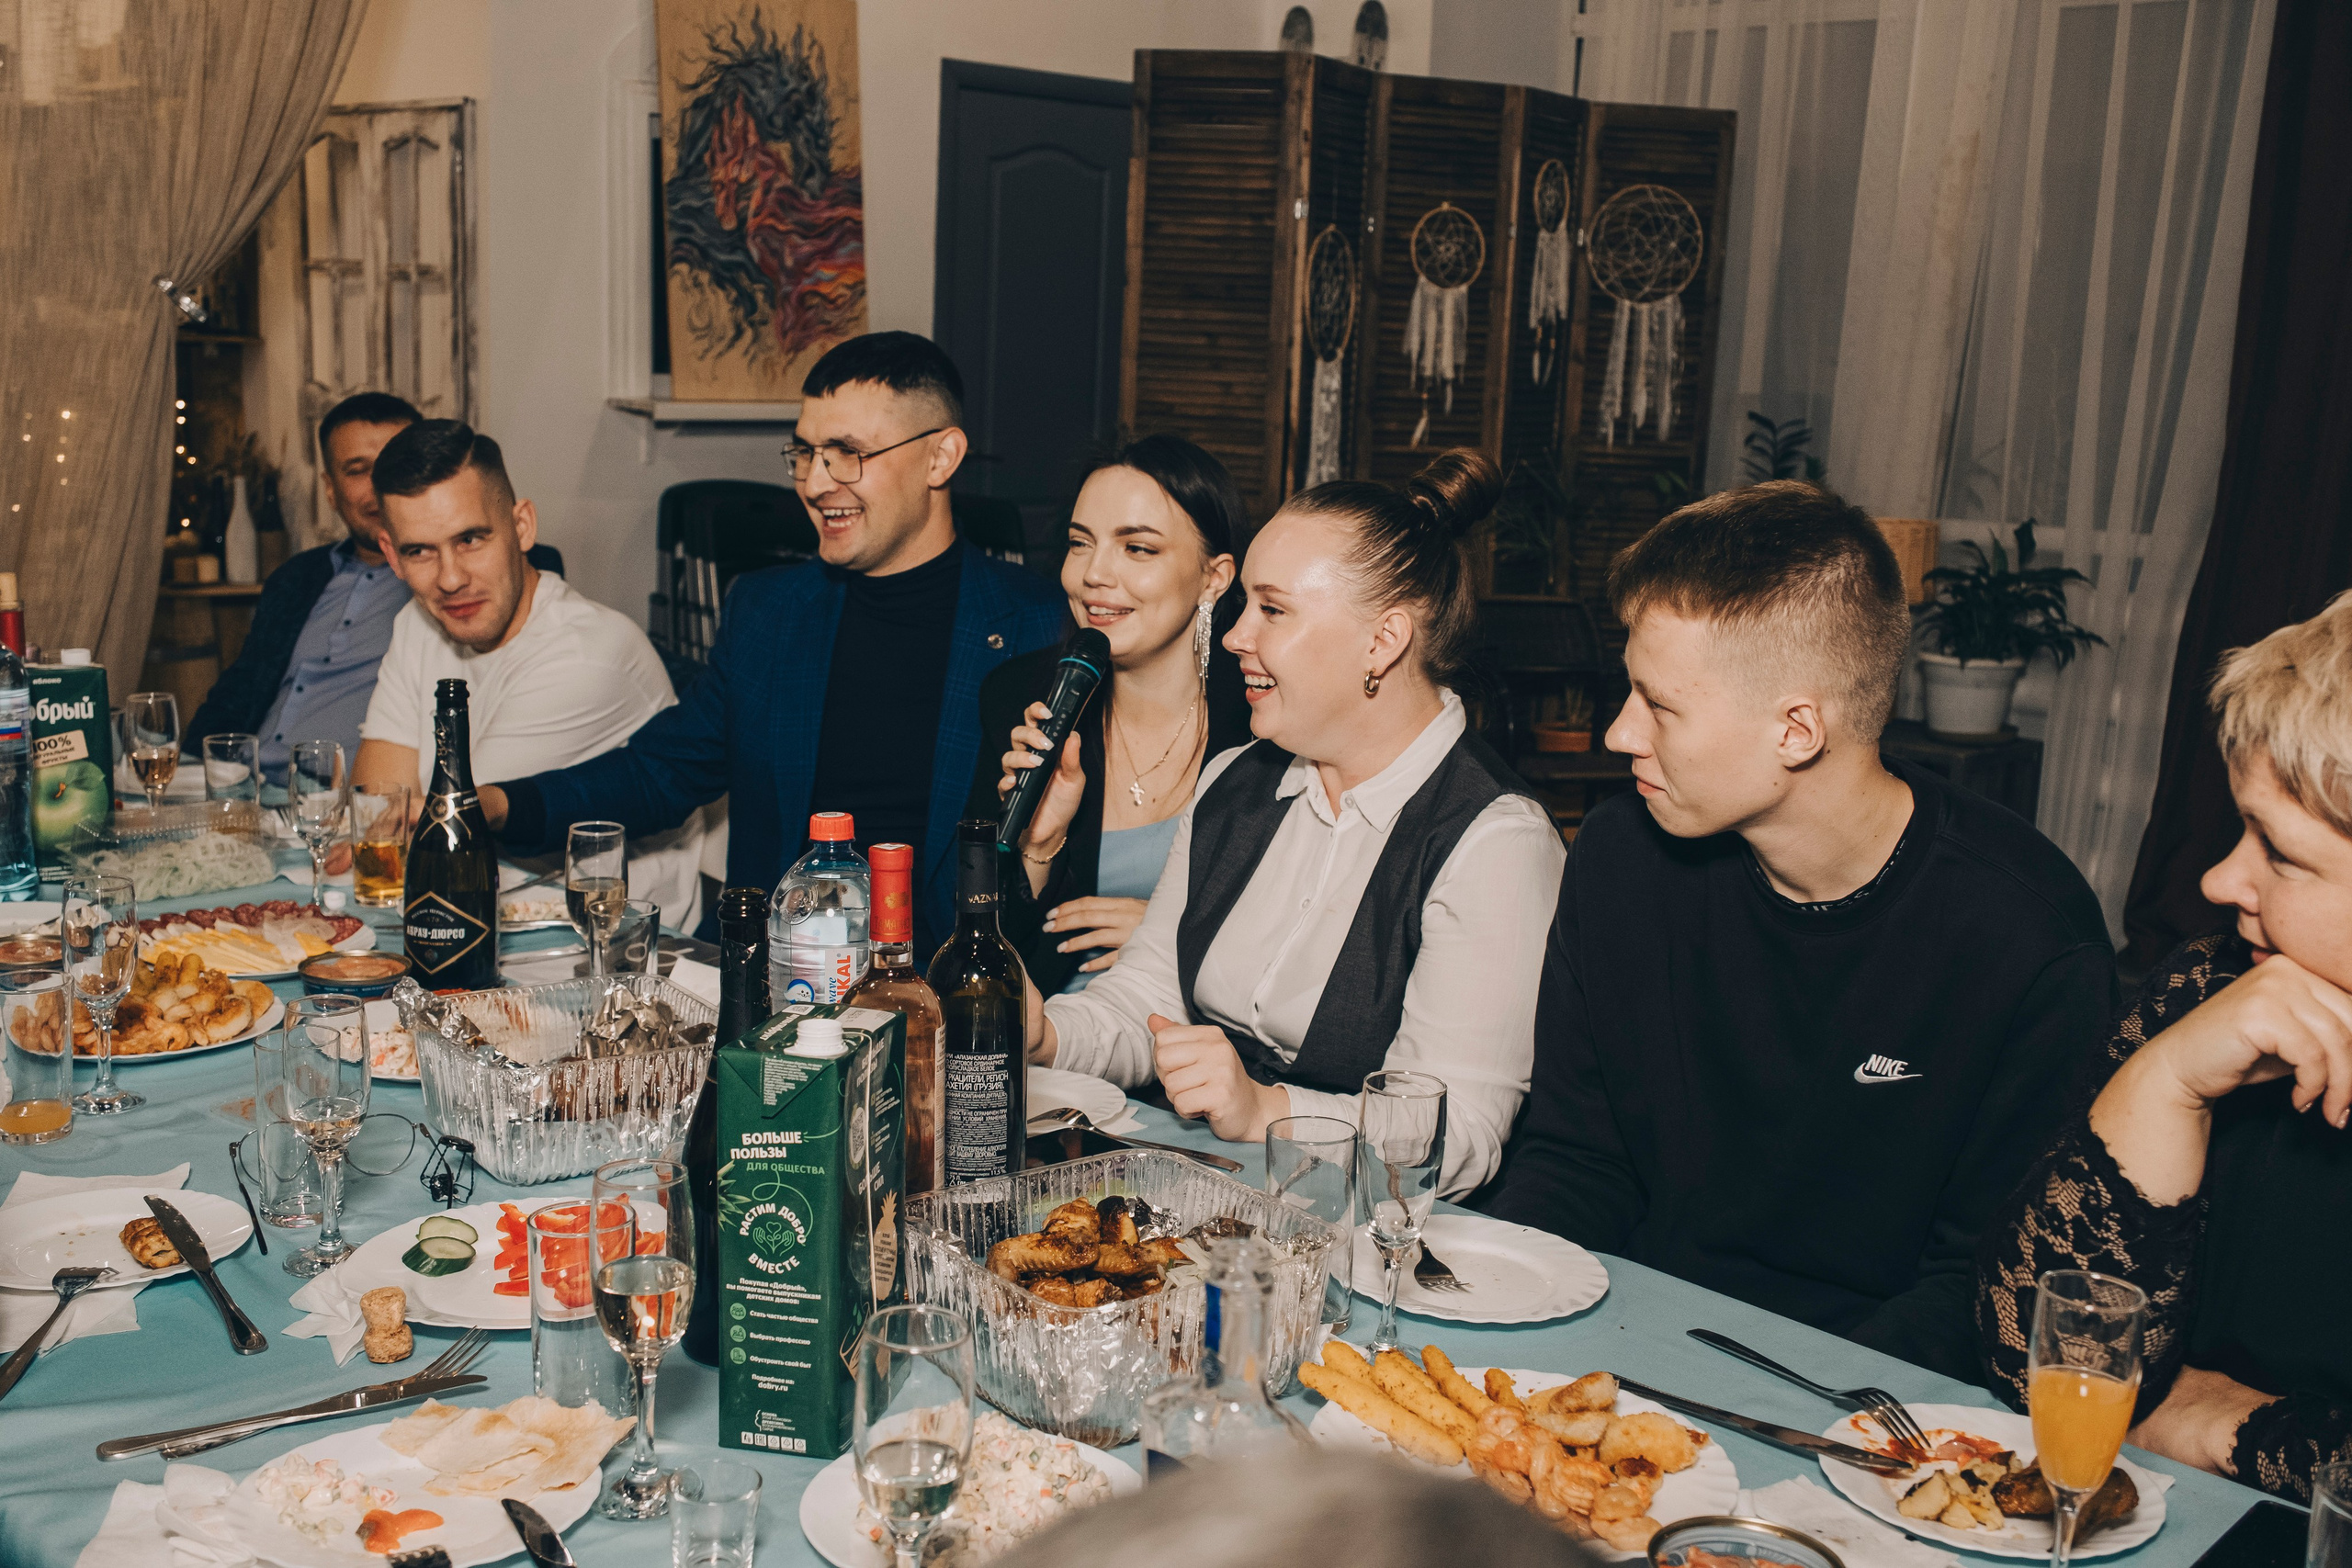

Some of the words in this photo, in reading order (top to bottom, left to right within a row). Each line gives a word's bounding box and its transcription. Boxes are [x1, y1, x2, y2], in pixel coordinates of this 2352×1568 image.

[29, 695, 94, 725] обрый
[406, 925, 466, 940] АБРАУ-ДЮРСО
[837, 955, 851, 998] IKAL
[1864, 1054, 1909, 1077] NIKE
[987, 1073, 1008, 1082] РЕГИОН
[946, 1082, 972, 1090] АХЕТИЯ
[741, 1132, 803, 1145] БОЛЬШЕ
[730, 1146, 787, 1159] ПОЛЬЗЫ
[746, 1162, 768, 1171] ДЛЯ
[770, 1163, 826, 1175] ОБЩЕСТВА
[739, 1202, 776, 1236] РАСТИМ
[777, 1205, 807, 1244] ДОБРО
[748, 1252, 800, 1274] ВМЕСТЕ
[739, 1277, 769, 1288] Покупая
[736, 1285, 773, 1295] помогаете
[773, 1290, 821, 1301] выпускникам
[746, 1292, 775, 1303] детских
[775, 1296, 800, 1305] домов:
[749, 1310, 766, 1318] Стать
[766, 1313, 788, 1321] частью
[788, 1314, 819, 1325] общества
[749, 1331, 775, 1341] Выбрать
[775, 1336, 811, 1346] профессию
[749, 1355, 785, 1366] Обустроить
[751, 1373, 786, 1384] Подробнее
[757, 1382, 789, 1392] dobry.ru
